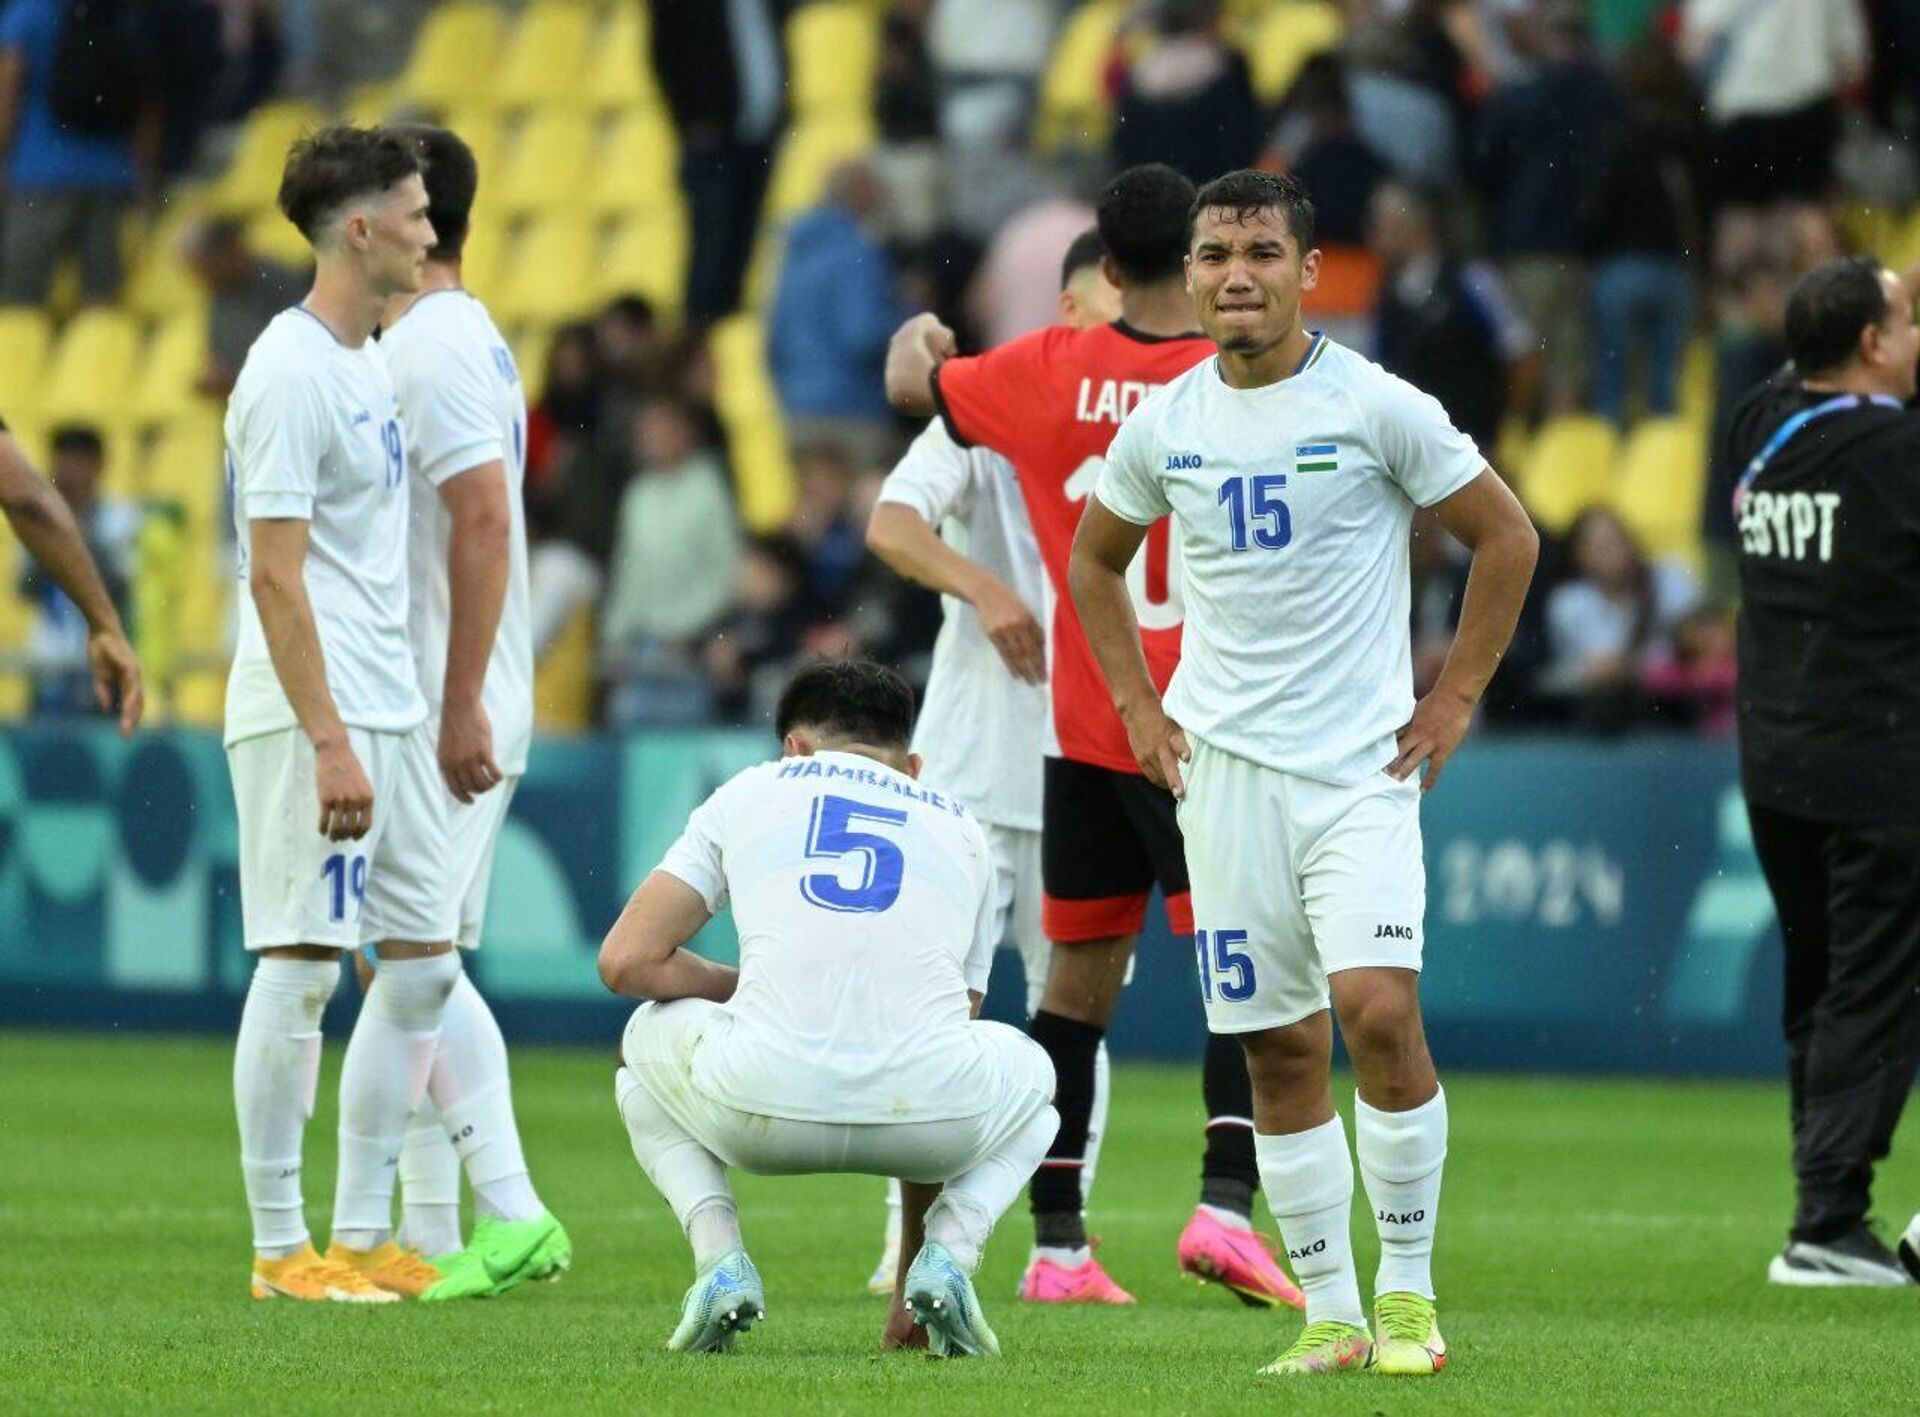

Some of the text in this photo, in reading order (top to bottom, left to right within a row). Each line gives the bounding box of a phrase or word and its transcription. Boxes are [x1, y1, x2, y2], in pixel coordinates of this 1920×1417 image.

[1166, 454, 1202, 470] JAKO
[1217, 474, 1292, 552] 15
[1739, 491, 1841, 562] EGYPT
[800, 795, 908, 914] 5
[1438, 838, 1625, 926] 2024
[1196, 929, 1256, 1003] 15
[1374, 924, 1413, 940] JAKO
[1287, 1238, 1326, 1260] AKO
[1377, 1209, 1425, 1225] JAKO
